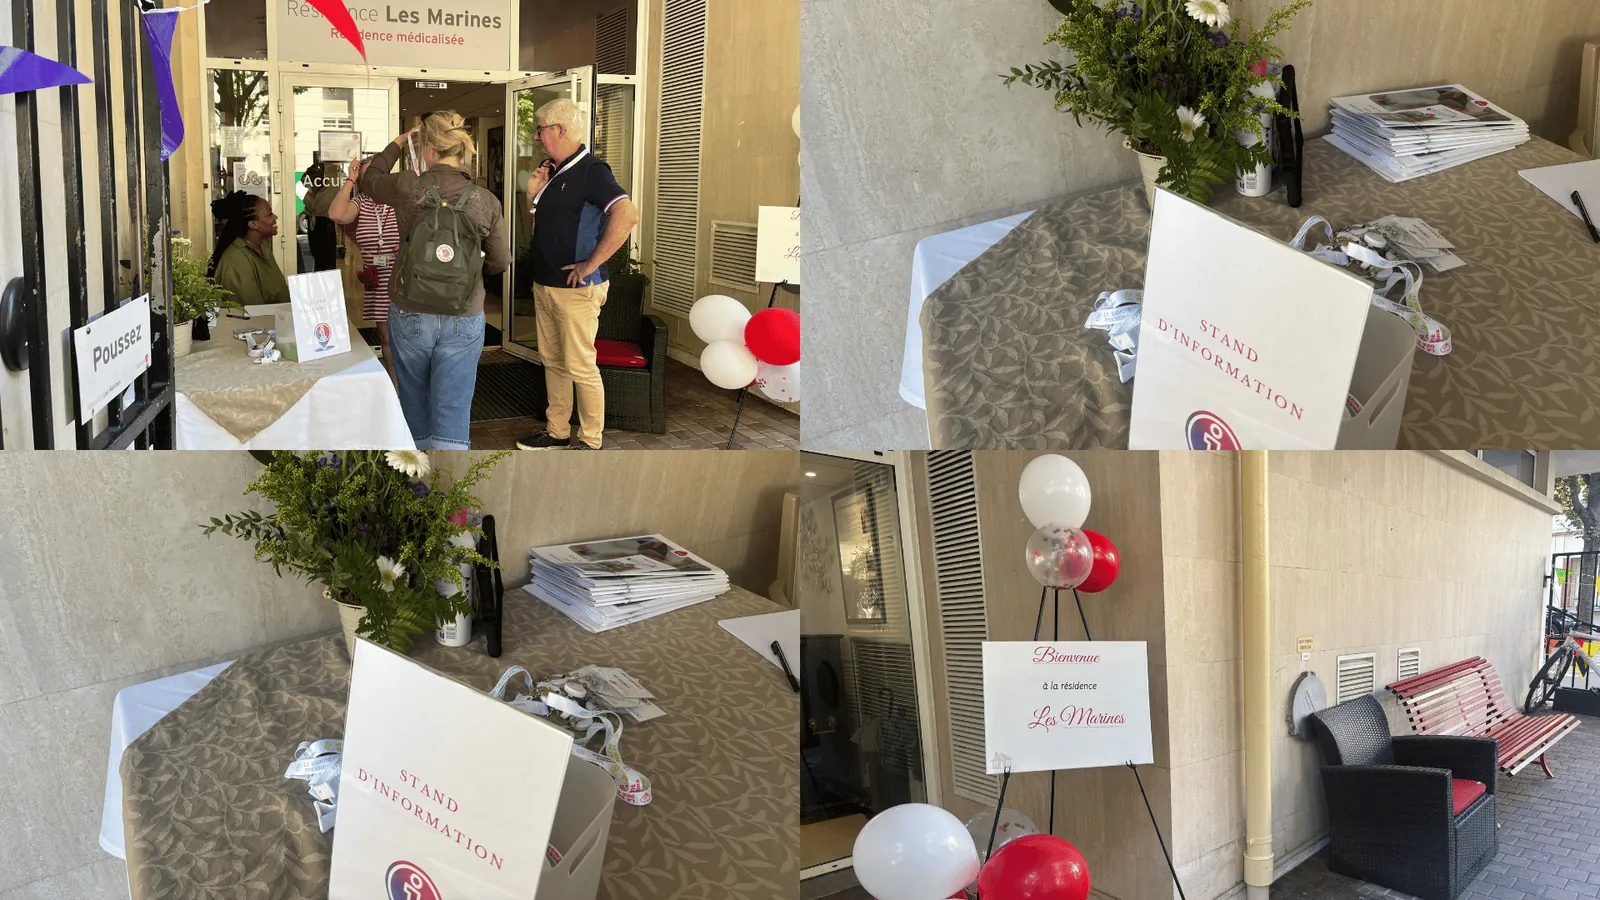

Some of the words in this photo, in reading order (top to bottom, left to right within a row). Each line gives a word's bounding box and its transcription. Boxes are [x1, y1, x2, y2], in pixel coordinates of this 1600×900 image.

[287, 0, 378, 22] Résnce
[386, 5, 420, 24] Les
[427, 8, 502, 29] Marines
[396, 32, 465, 46] médicalisée
[303, 174, 347, 188] Accue
[93, 324, 142, 372] Poussez
[1199, 319, 1259, 363] STAND
[1158, 318, 1304, 421] D'INFORMATION
[1032, 646, 1100, 663] Bienvenue
[1042, 682, 1049, 690] à
[1050, 681, 1059, 690] la
[1061, 681, 1097, 690] résidence
[1027, 705, 1057, 733] Les
[1060, 704, 1126, 726] Marines
[400, 769, 459, 813] STAND
[358, 768, 505, 870] D'INFORMATION
